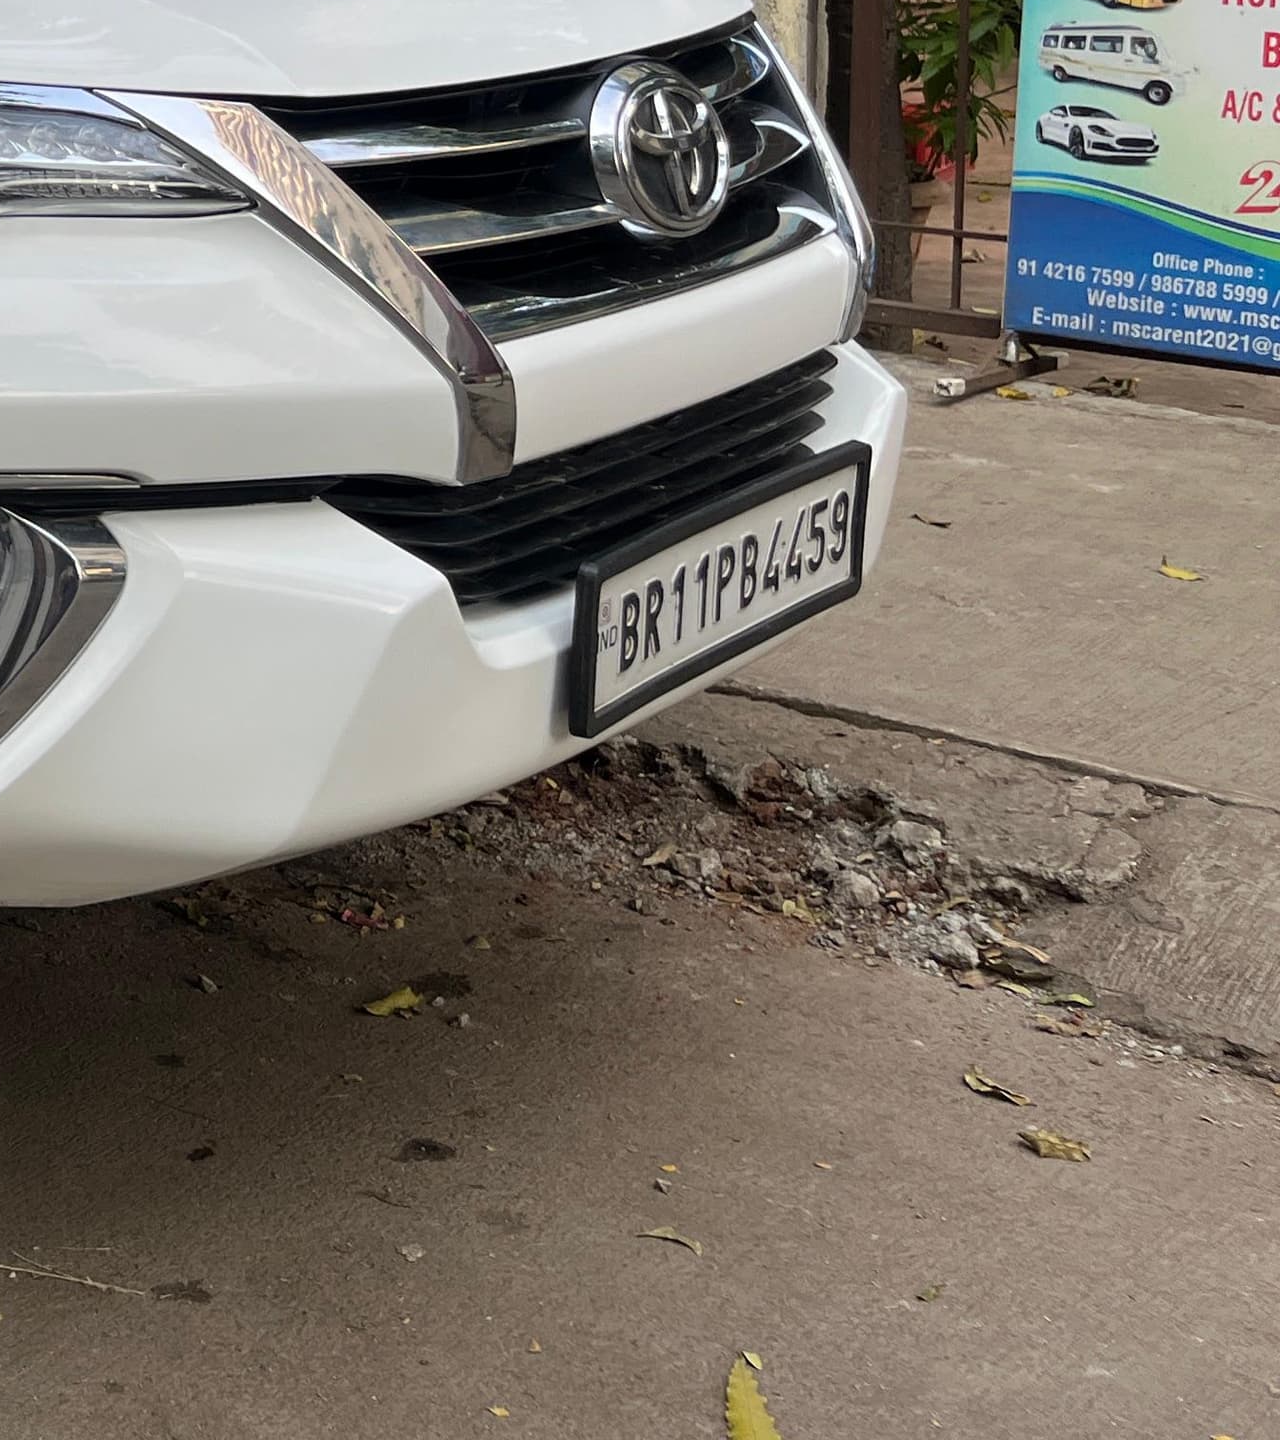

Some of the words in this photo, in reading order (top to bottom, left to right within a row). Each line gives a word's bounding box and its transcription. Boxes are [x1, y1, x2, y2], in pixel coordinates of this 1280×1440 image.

[1221, 89, 1263, 123] A/C
[1017, 258, 1037, 276] 91
[1042, 261, 1086, 283] 4216
[1091, 266, 1135, 289] 7599
[1151, 274, 1218, 299] 986788
[1222, 282, 1269, 306] 5999
[1152, 251, 1198, 273] Office
[1203, 256, 1254, 279] Phone
[1086, 287, 1165, 315] Website
[1183, 303, 1280, 331] www.msc
[1031, 306, 1094, 333] E-mail
[1112, 320, 1280, 361] mscarent2021@g
[617, 488, 850, 676] BR11PB4459
